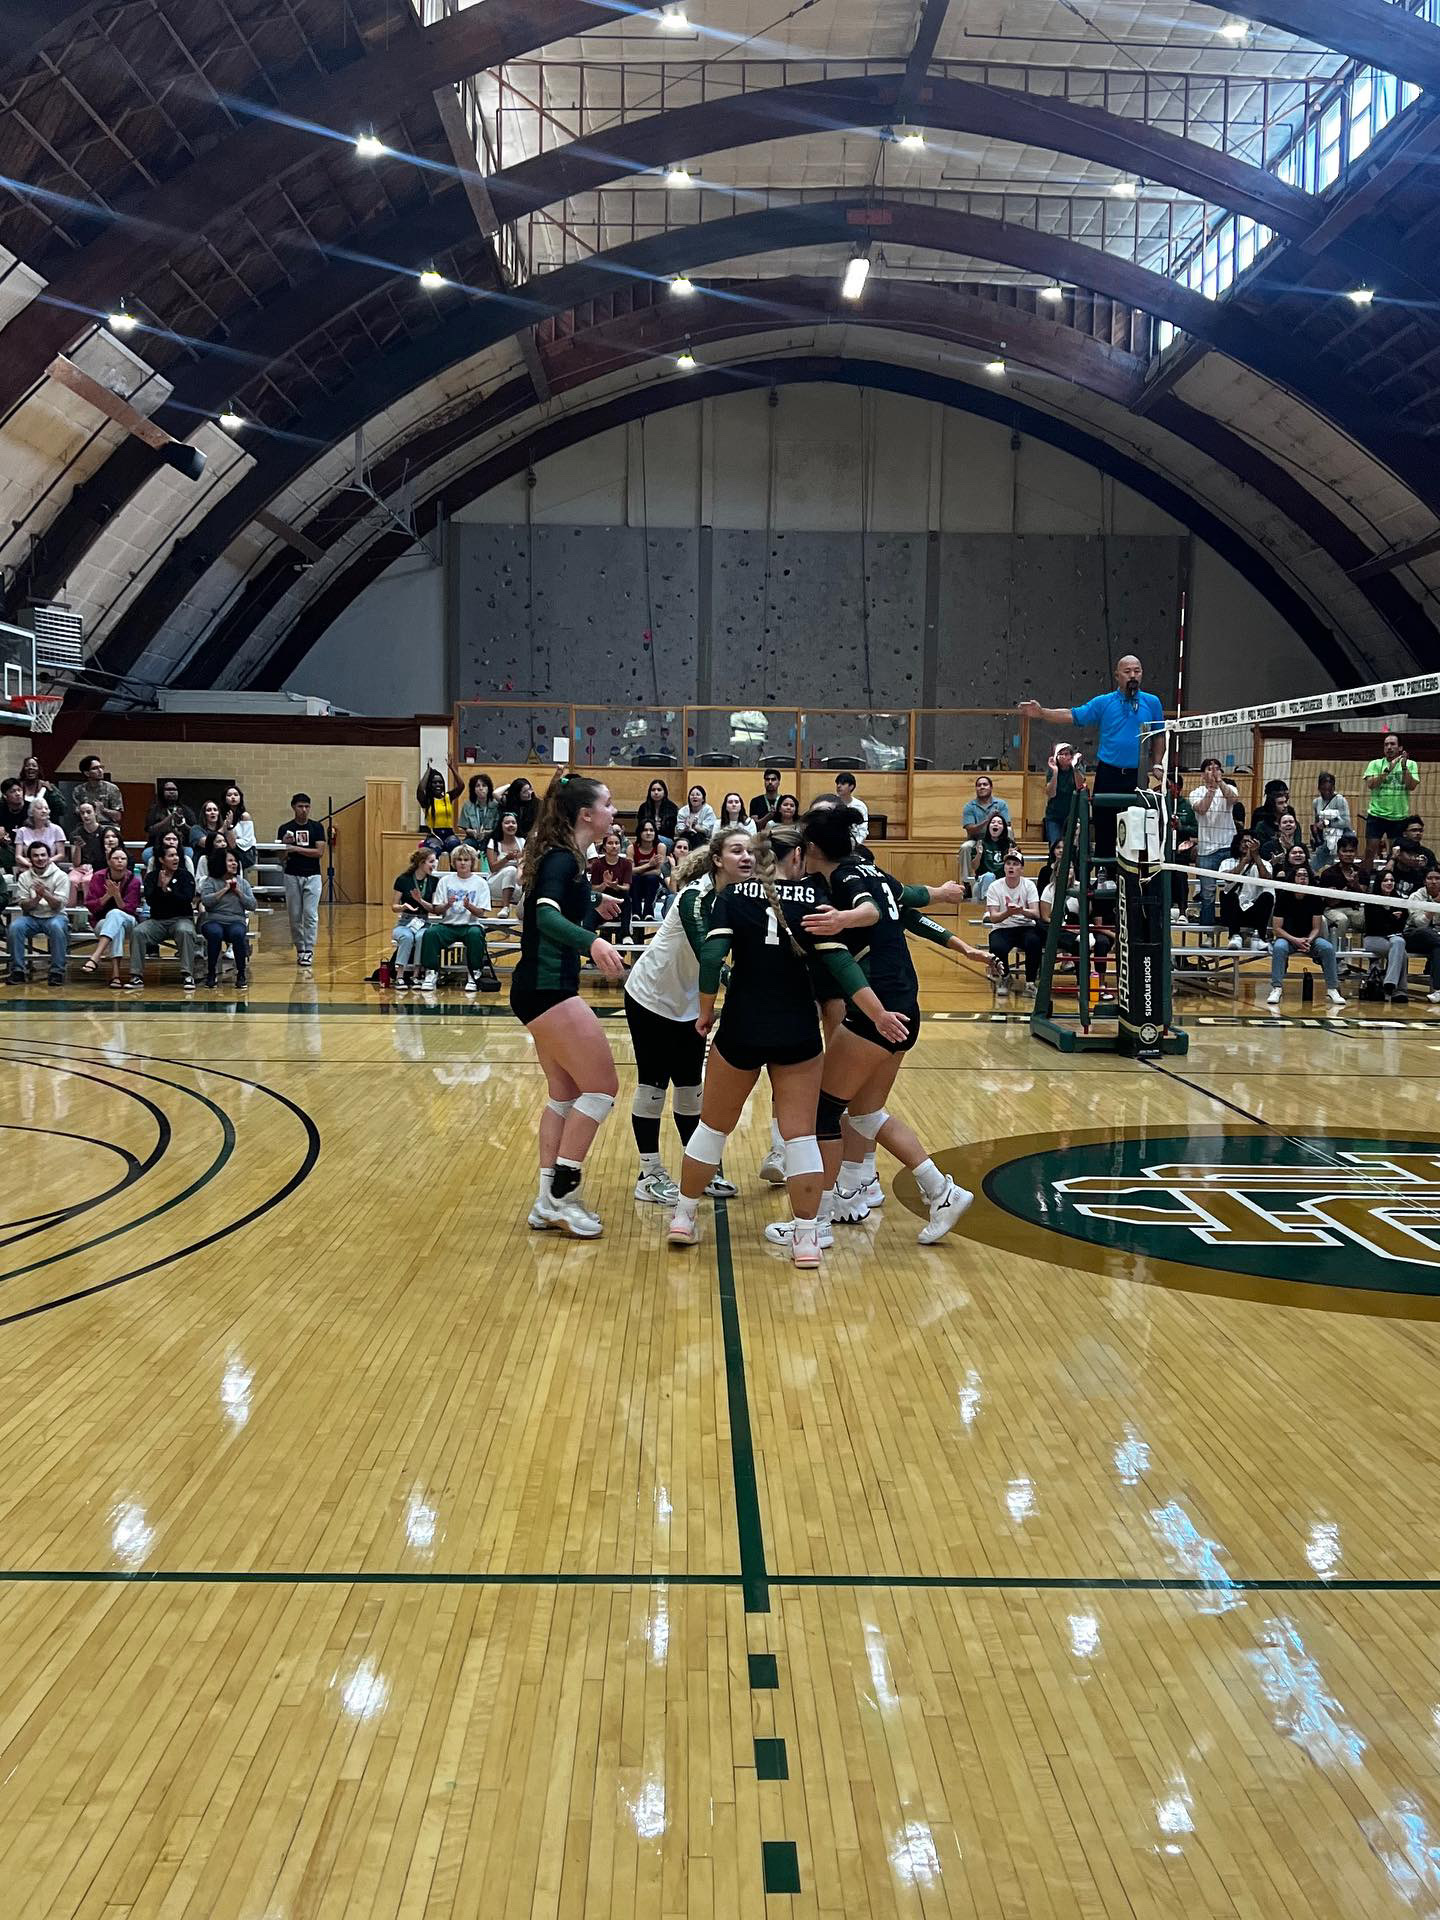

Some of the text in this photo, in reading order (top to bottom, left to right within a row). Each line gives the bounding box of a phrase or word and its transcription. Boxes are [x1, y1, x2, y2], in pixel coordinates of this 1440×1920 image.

[881, 882, 899, 920] 3
[765, 907, 779, 945] 1
[1143, 956, 1152, 1017] sports imports
